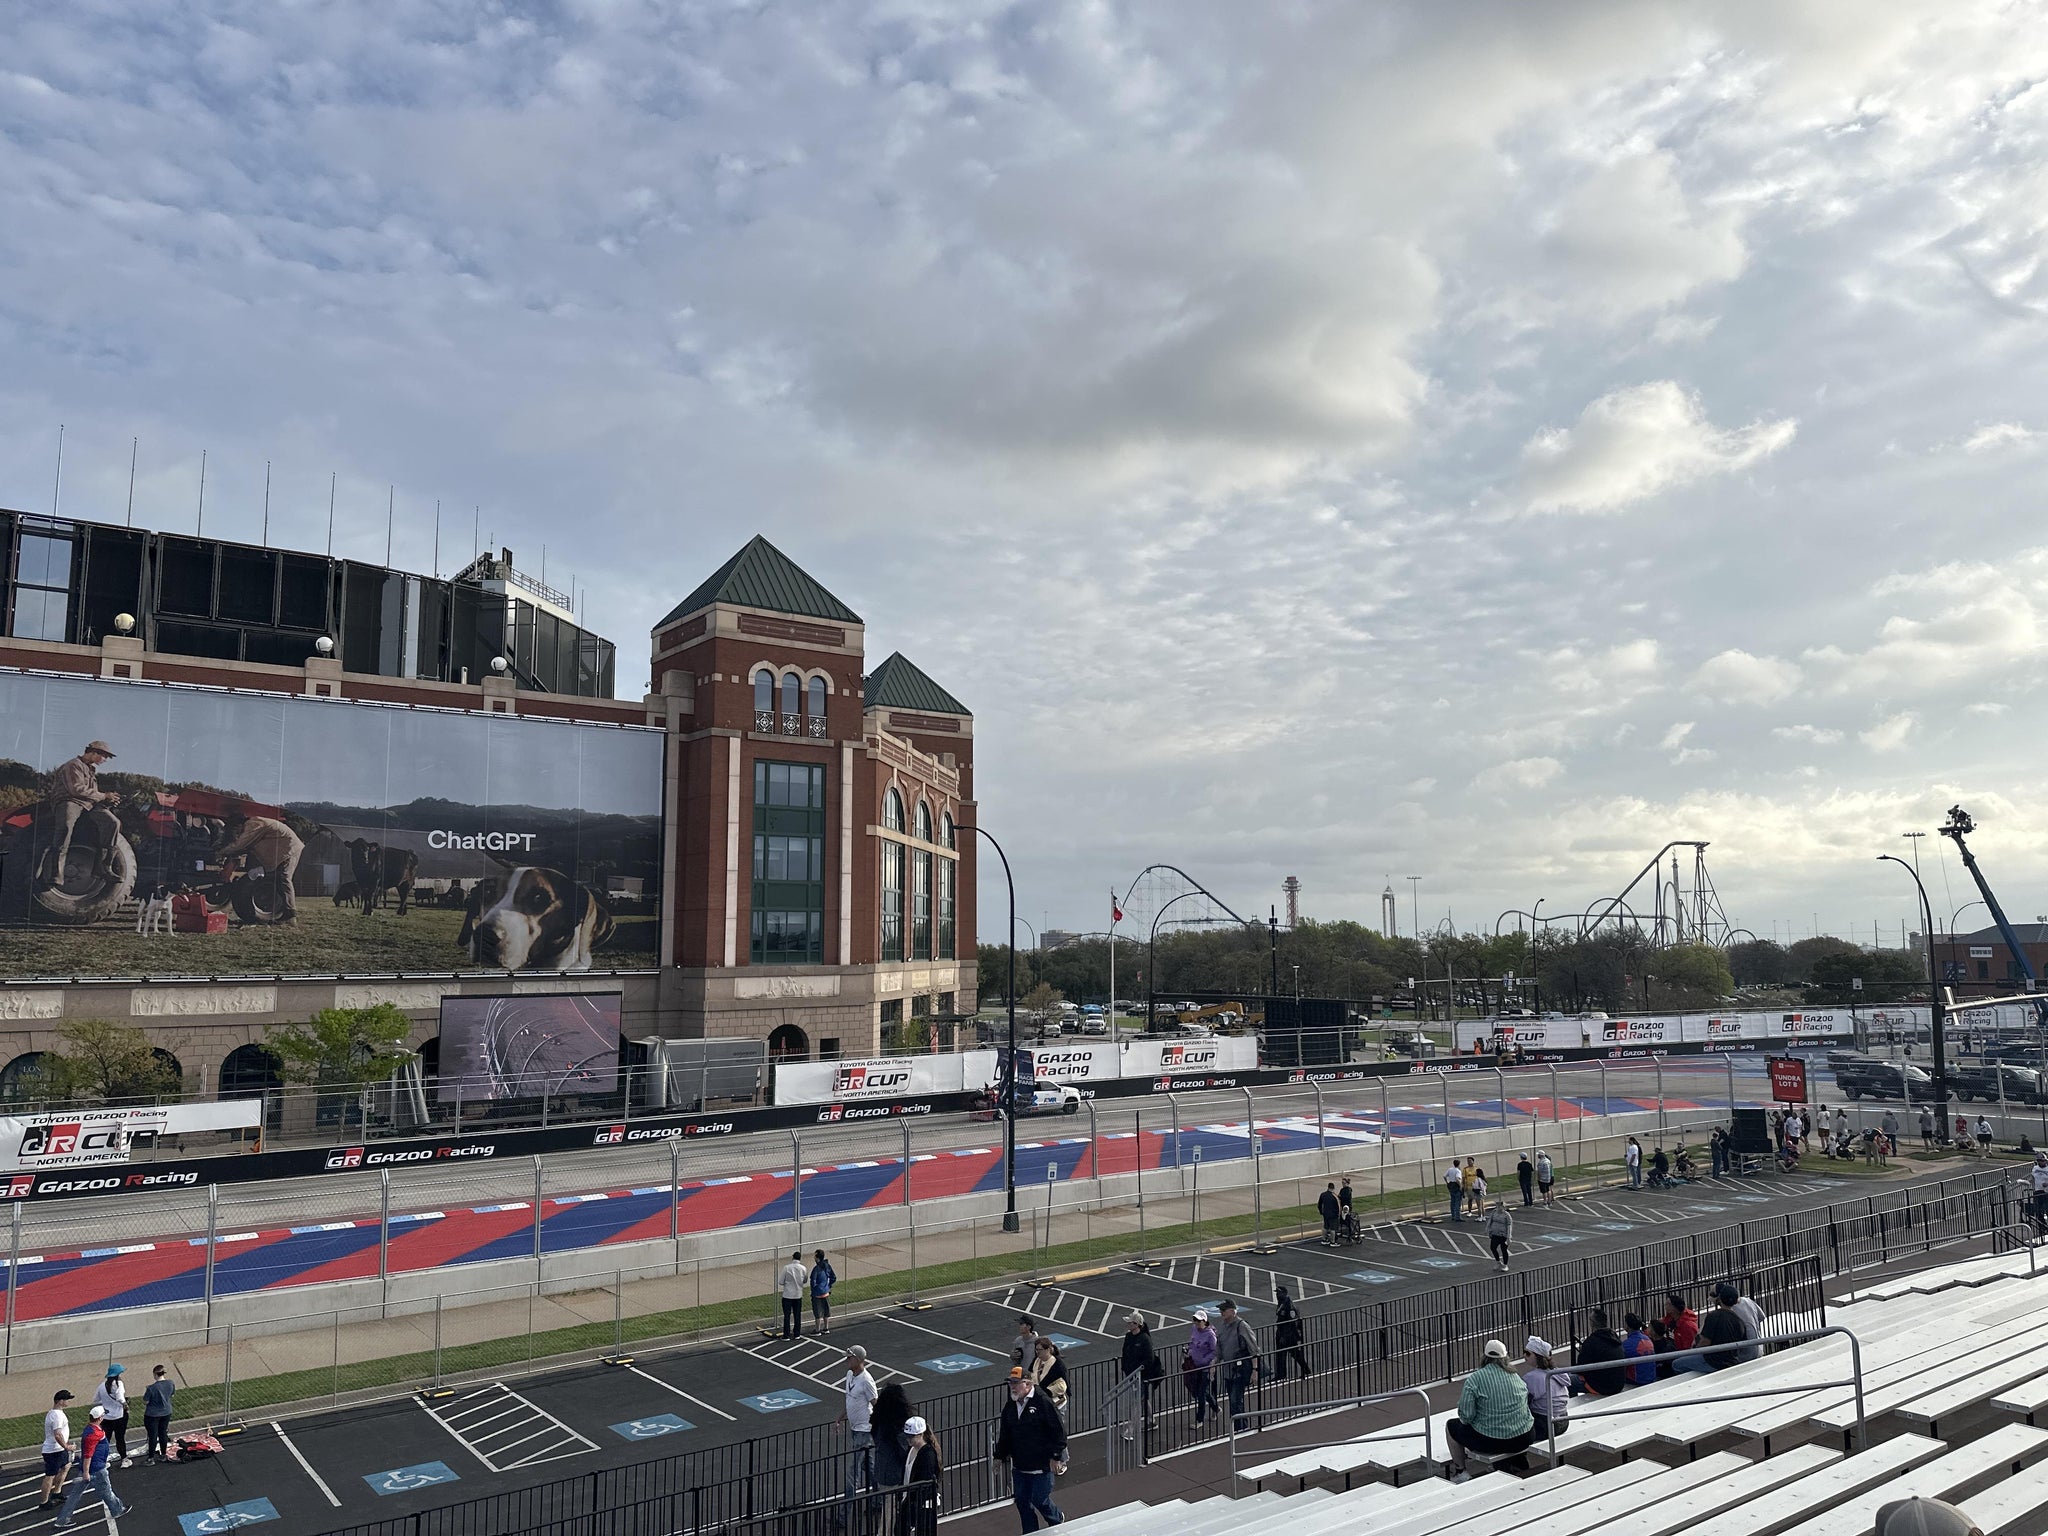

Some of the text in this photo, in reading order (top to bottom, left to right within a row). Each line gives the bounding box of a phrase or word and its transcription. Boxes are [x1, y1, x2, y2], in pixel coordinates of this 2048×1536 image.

[427, 829, 536, 852] ChatGPT
[1603, 1022, 1664, 1041] GR GAZOO
[1708, 1023, 1742, 1033] GR CUP
[1782, 1019, 1802, 1032] GR
[1803, 1023, 1833, 1031] Racing
[1515, 1032, 1545, 1041] CUP
[1629, 1031, 1663, 1040] Racing
[1608, 1050, 1622, 1058] GR
[1647, 1048, 1668, 1056] Racing
[1703, 1044, 1714, 1052] GR
[1736, 1043, 1755, 1051] Racing
[1038, 1052, 1092, 1064] GAZOO
[1161, 1052, 1215, 1065] GR CUP
[1536, 1054, 1563, 1062] Racing
[1035, 1064, 1090, 1076] Racing
[1410, 1062, 1479, 1073] GR GAZOO Racing
[866, 1073, 908, 1087] CUP
[1289, 1070, 1364, 1082] GR GAZOO Racing
[1153, 1077, 1236, 1091] GR GAZOO Racing
[842, 1089, 898, 1098] NORTH AMERICA
[31, 1110, 168, 1125] TOYOTA GAZOO Racing
[818, 1103, 931, 1121] GR GAZOO Racing
[594, 1123, 733, 1144] GR GAZOO Racing
[36, 1156, 81, 1166] NORTH
[327, 1145, 495, 1168] GR GAZOO Racing
[38, 1178, 121, 1193] GAZOO
[125, 1171, 198, 1186] Racing
